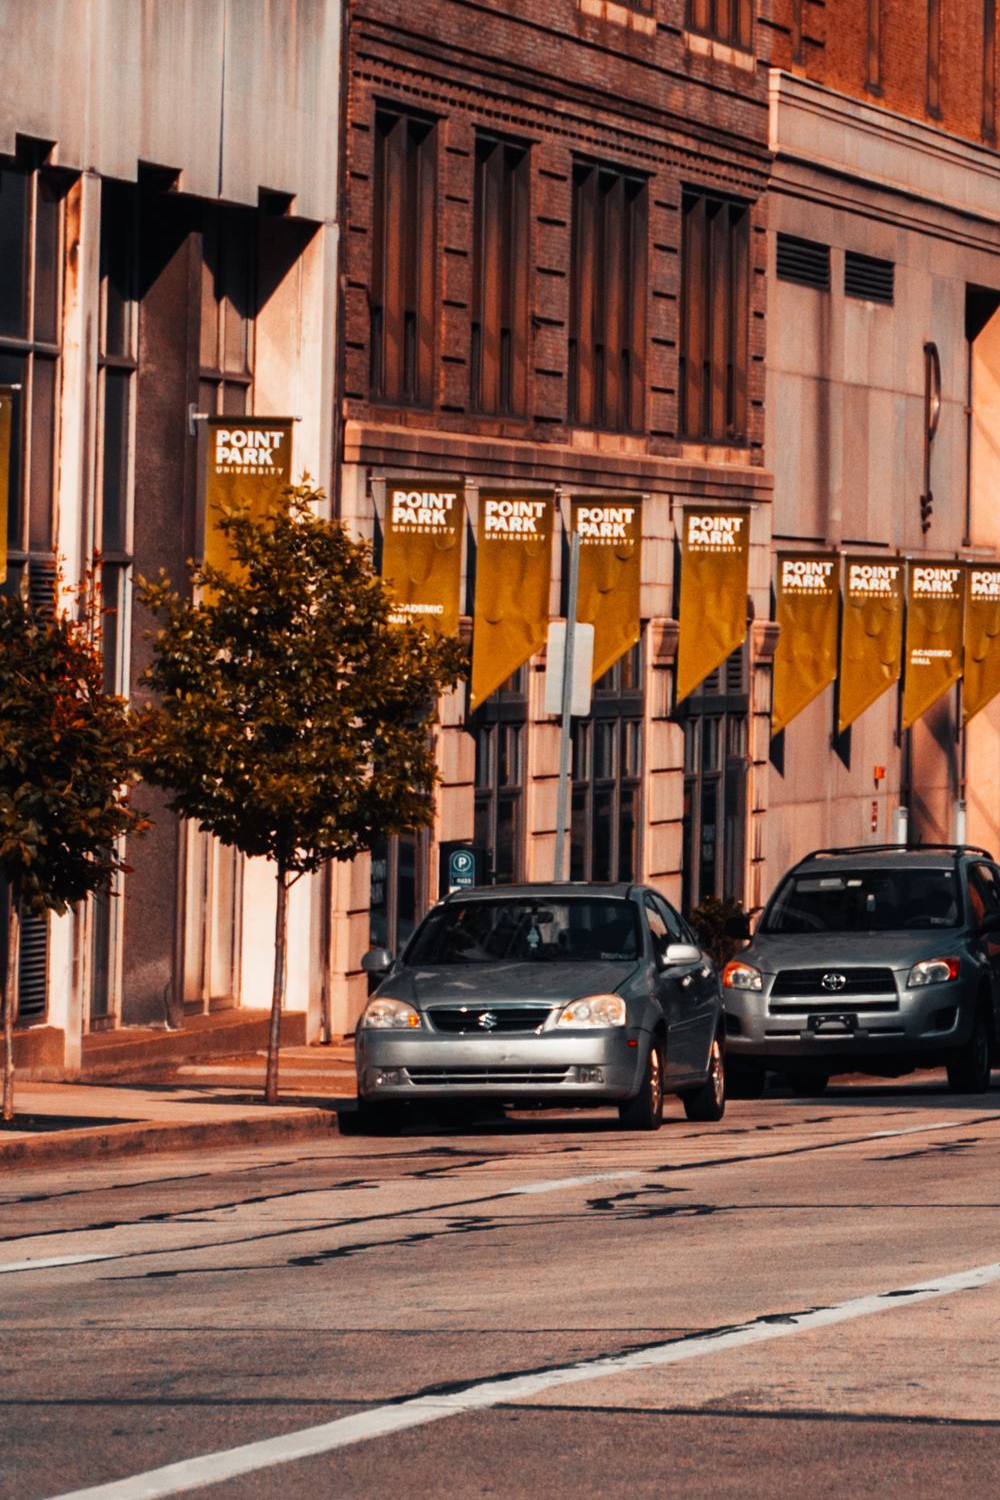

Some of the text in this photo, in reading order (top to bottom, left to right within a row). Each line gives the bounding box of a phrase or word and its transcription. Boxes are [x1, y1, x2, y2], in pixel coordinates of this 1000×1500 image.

[216, 429, 284, 448] POINT
[216, 446, 274, 465] PARK
[216, 466, 284, 475] UNIVERSITY
[392, 491, 457, 510] POINT
[392, 508, 447, 525] PARK
[485, 500, 546, 518] POINT
[577, 508, 635, 523] POINT
[392, 525, 456, 534] UNIVERSITY
[484, 516, 537, 532] PARK
[577, 522, 626, 537] PARK
[688, 516, 743, 532] POINT
[484, 533, 545, 541] UNIVERSITY
[688, 530, 735, 545] PARK
[782, 561, 834, 576] POINT
[850, 565, 899, 580] POINT
[913, 568, 961, 581] POINT
[782, 574, 826, 588] PARK
[849, 578, 892, 591] PARK
[913, 580, 954, 593] PARK
